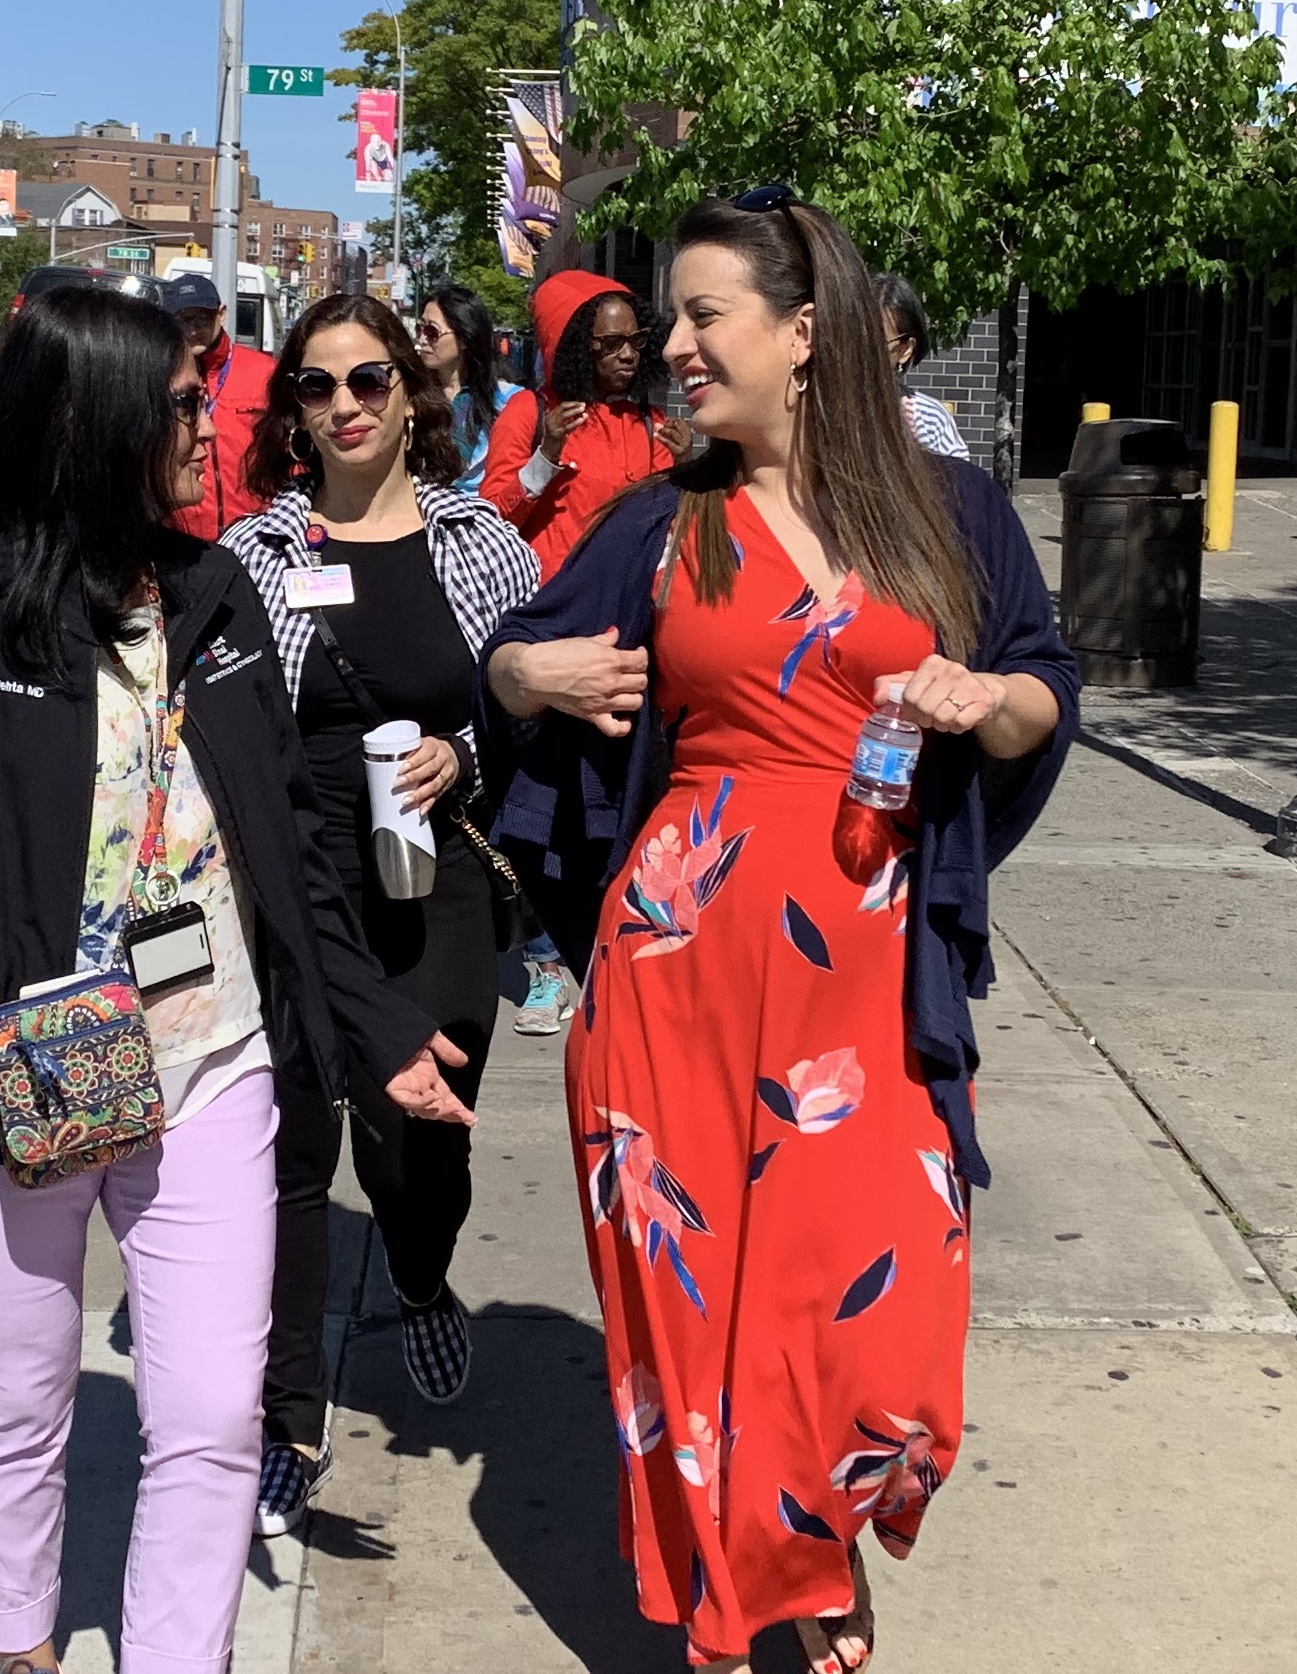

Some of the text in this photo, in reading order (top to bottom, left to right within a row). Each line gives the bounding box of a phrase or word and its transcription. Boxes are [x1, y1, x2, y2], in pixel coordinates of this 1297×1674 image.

[267, 69, 314, 91] 79 St
[27, 685, 44, 698] MD
